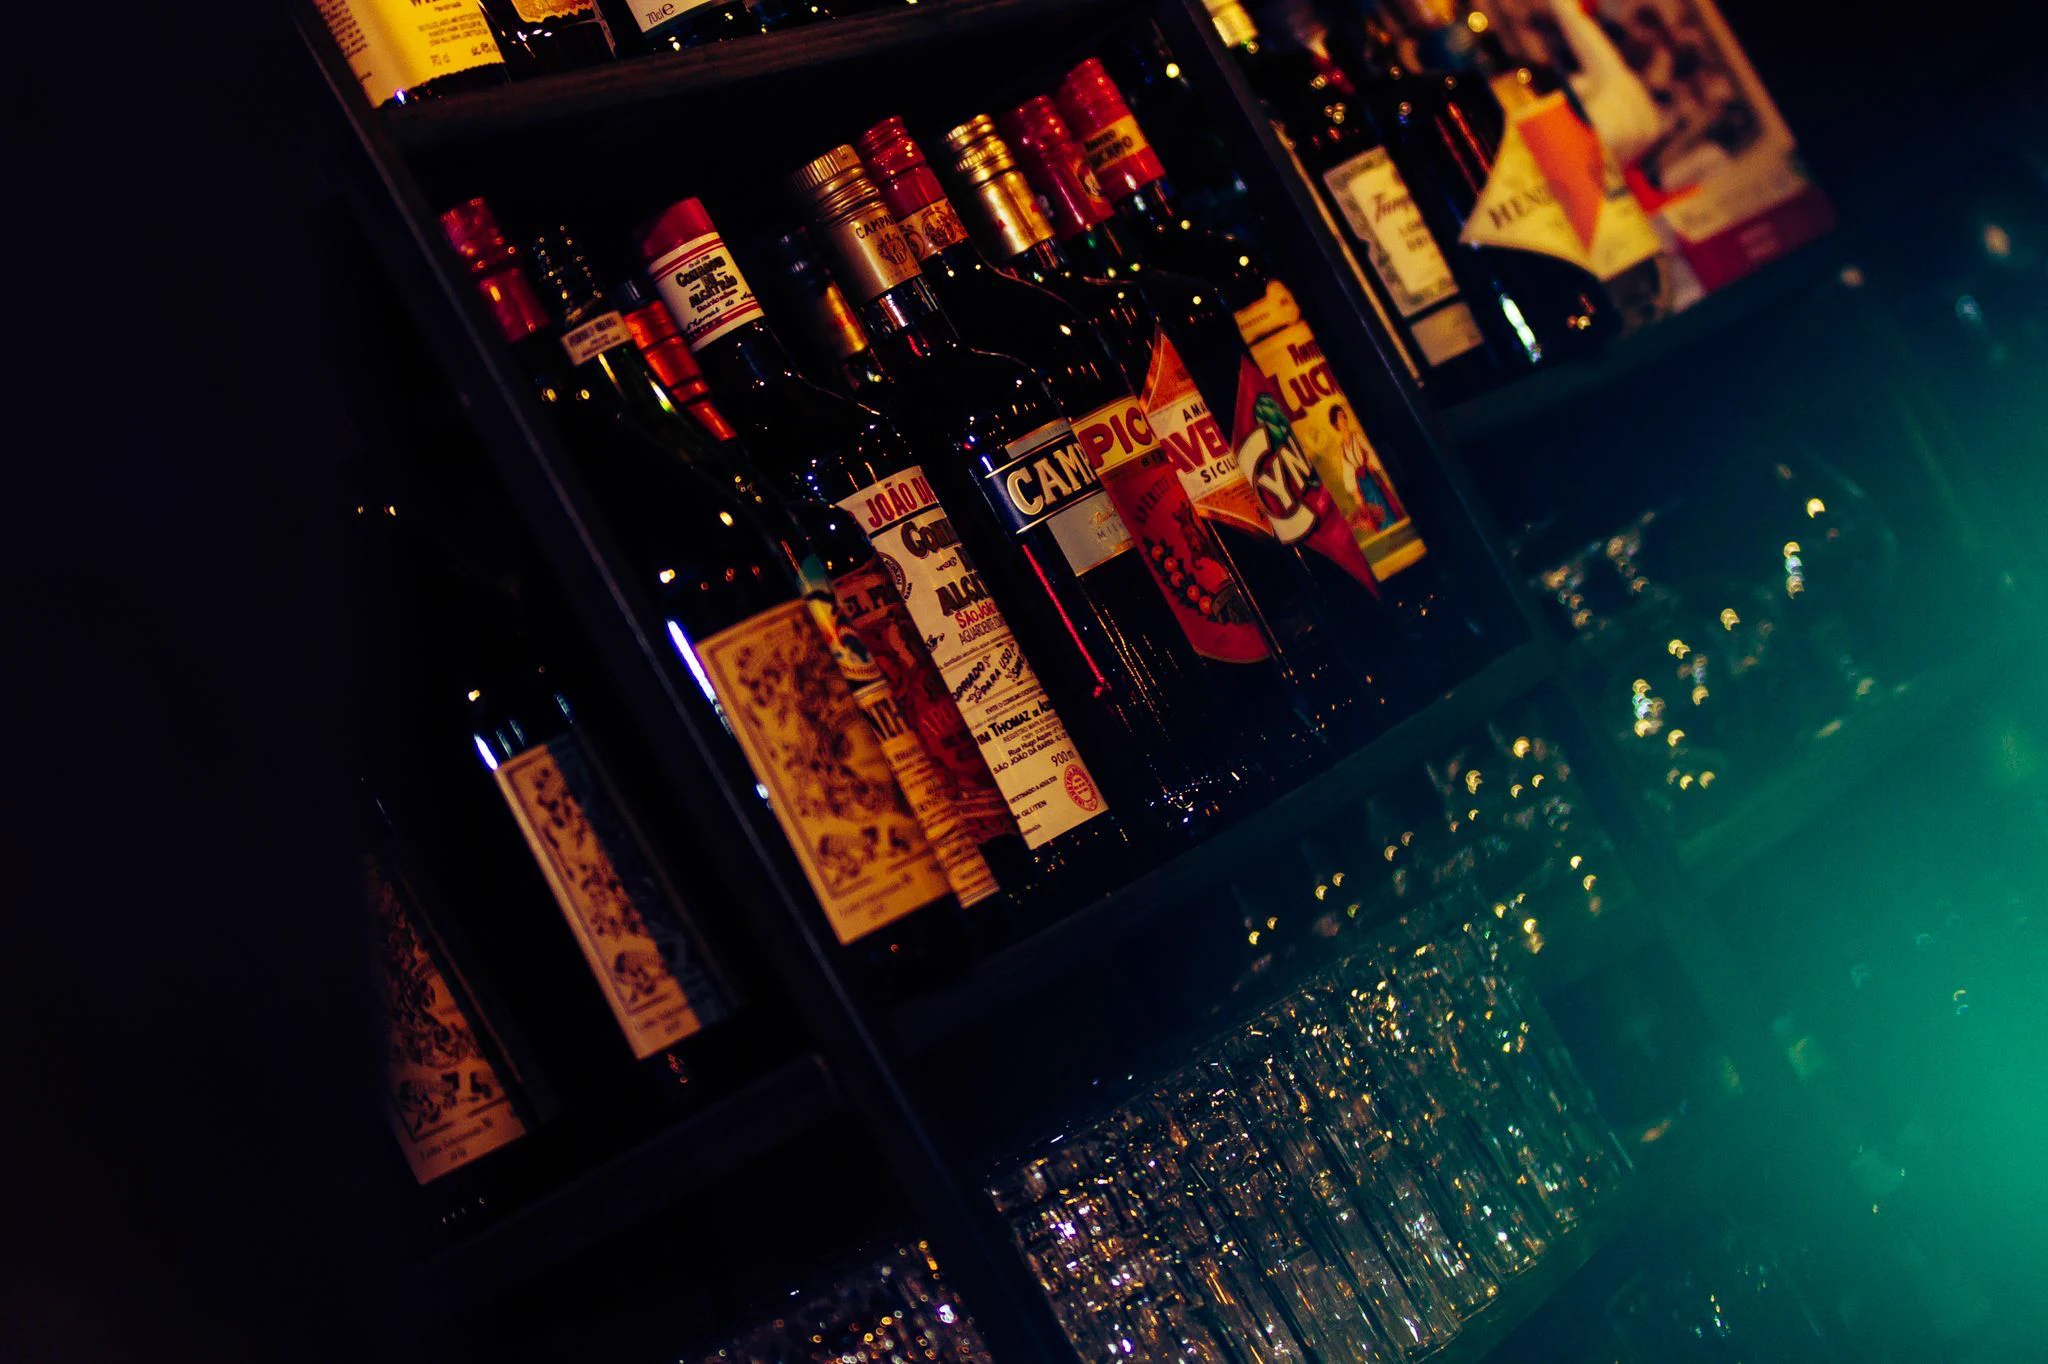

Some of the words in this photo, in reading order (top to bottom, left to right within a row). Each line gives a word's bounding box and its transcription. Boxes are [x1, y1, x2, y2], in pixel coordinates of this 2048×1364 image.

[866, 482, 916, 528] JOÃO
[981, 668, 1001, 693] PARA
[1008, 746, 1021, 756] Rua
[1027, 746, 1038, 756] DA
